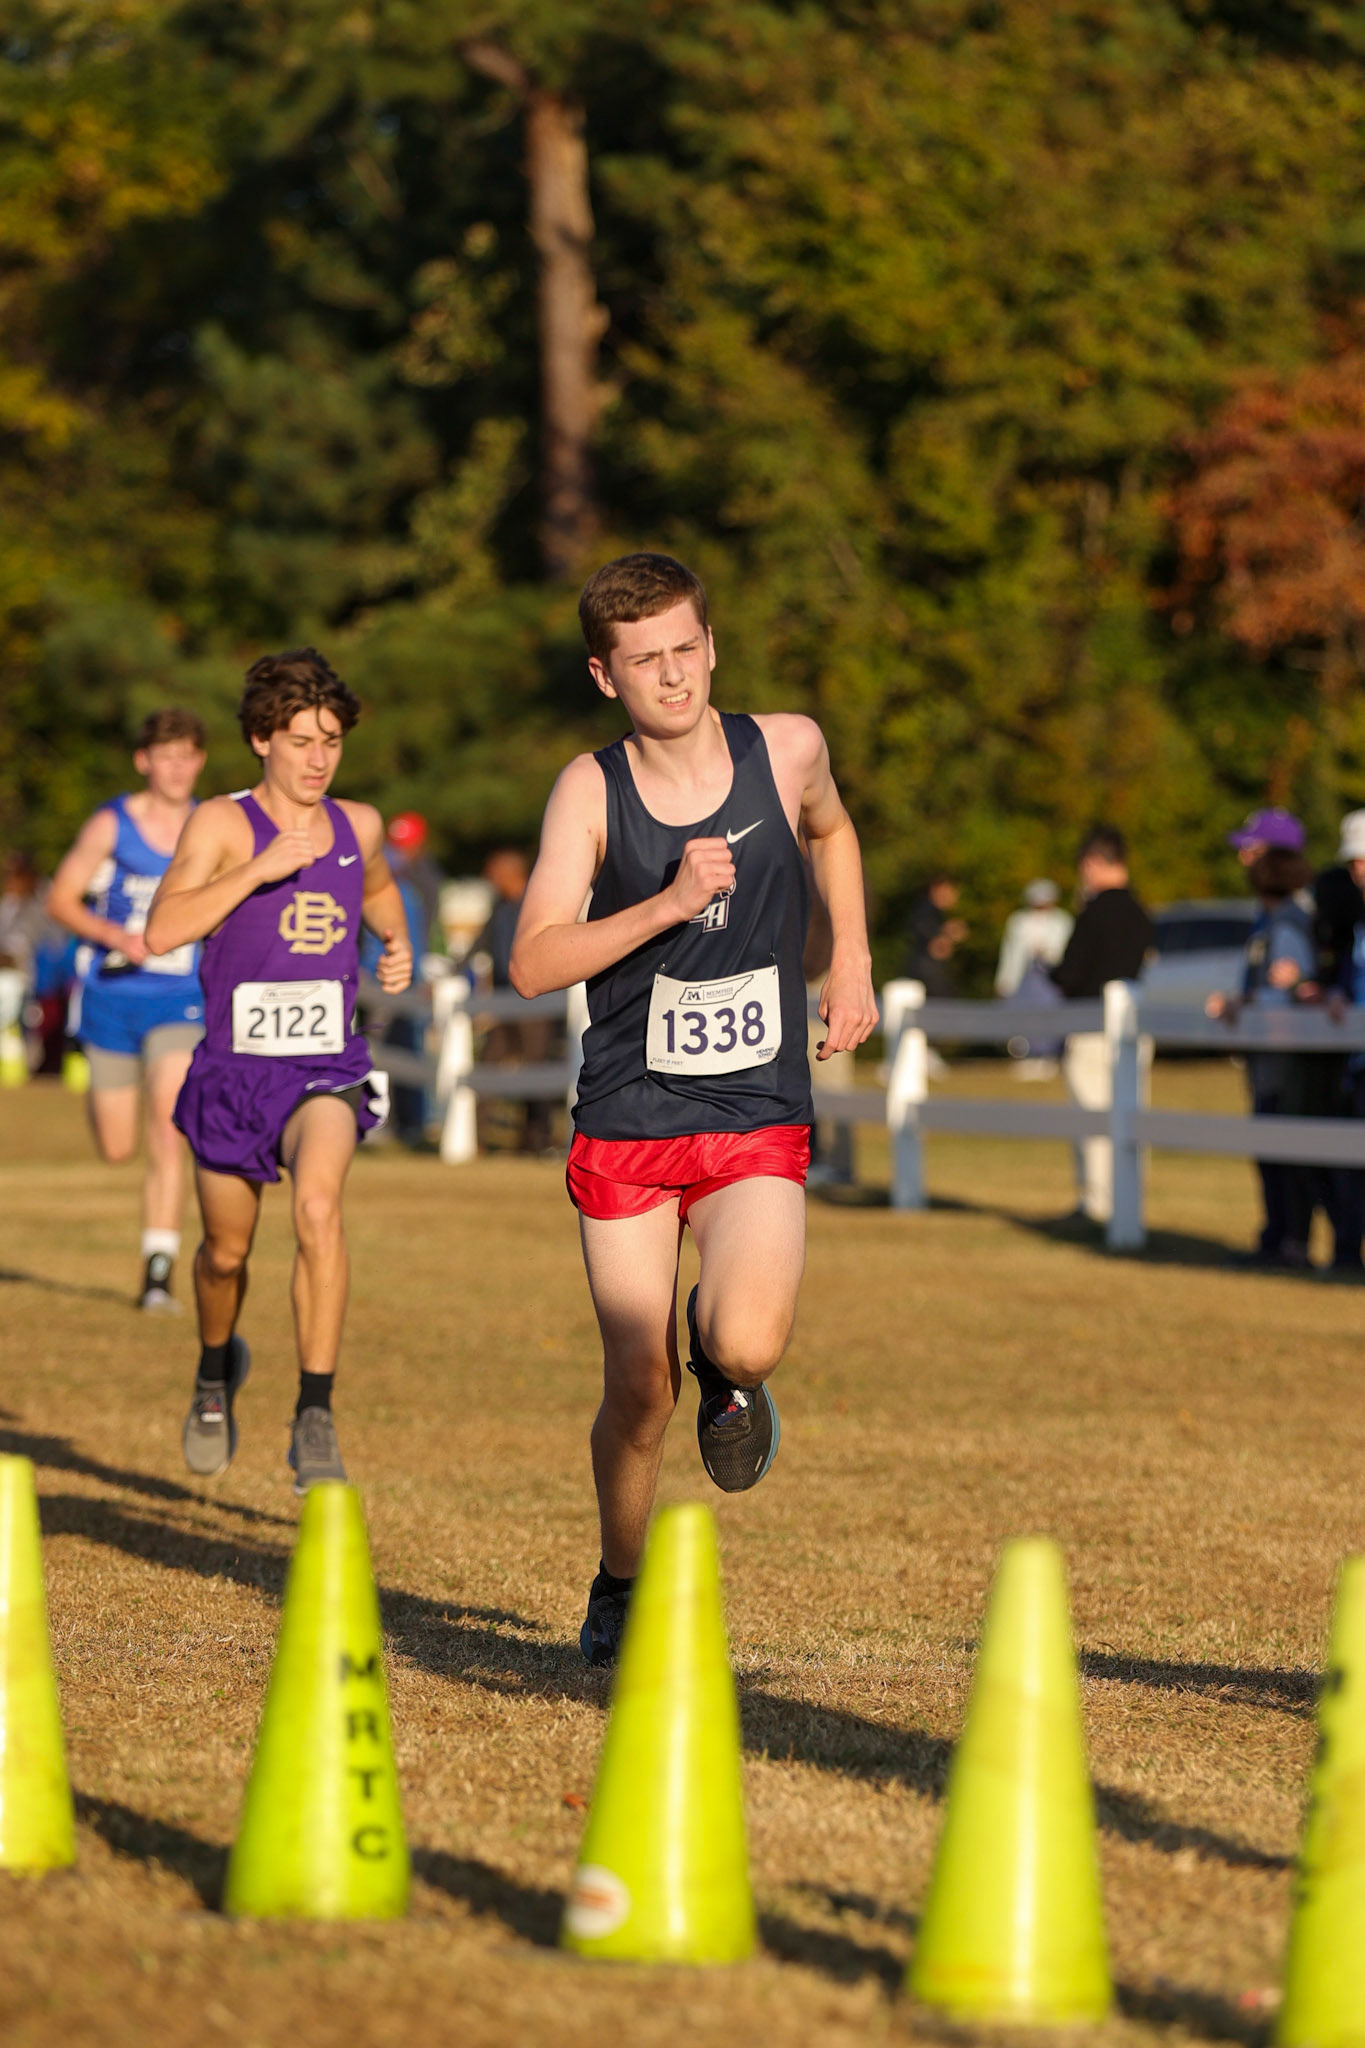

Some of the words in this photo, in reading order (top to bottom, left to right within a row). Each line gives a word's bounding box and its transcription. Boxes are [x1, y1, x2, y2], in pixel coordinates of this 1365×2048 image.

[686, 991, 701, 1001] M
[248, 1005, 327, 1039] 2122
[662, 1000, 766, 1055] 1338
